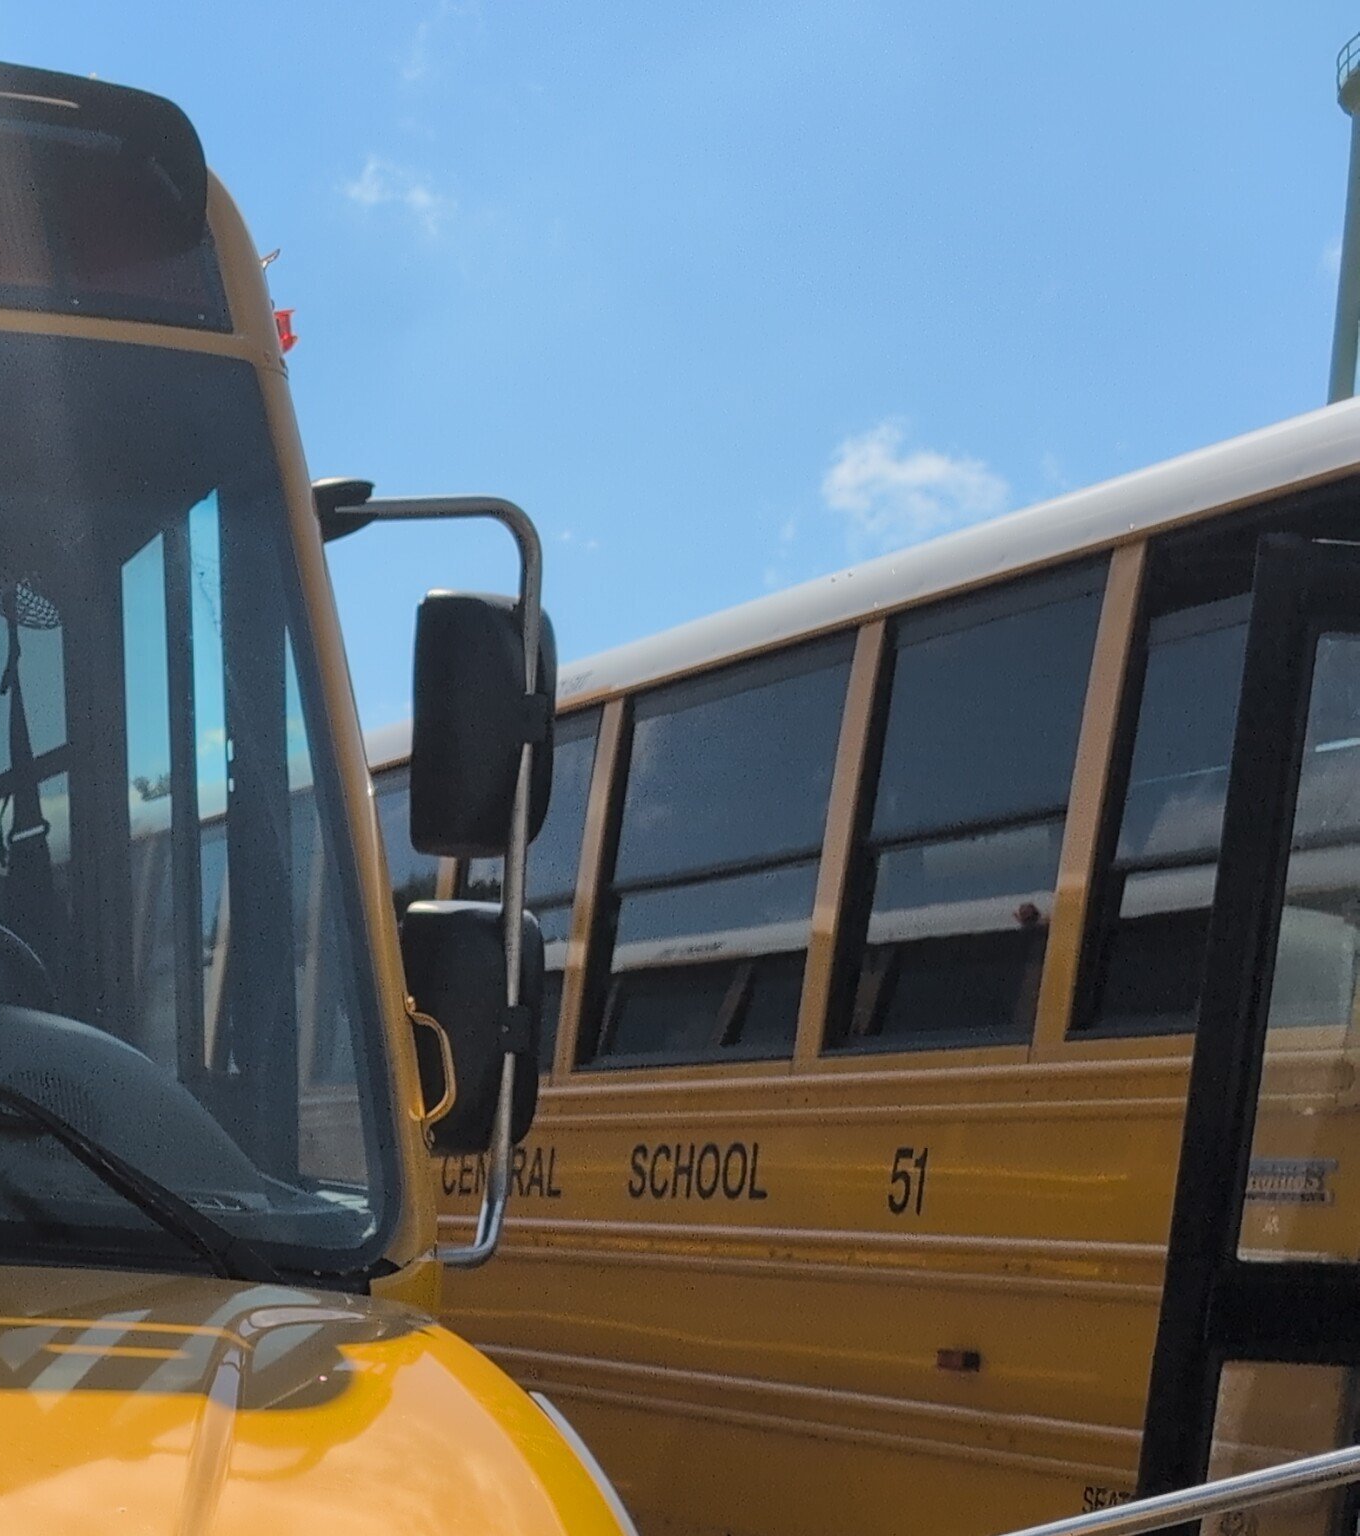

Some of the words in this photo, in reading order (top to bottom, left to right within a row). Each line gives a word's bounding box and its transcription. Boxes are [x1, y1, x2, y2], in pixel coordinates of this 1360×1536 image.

[441, 1147, 562, 1197] CENRAL
[628, 1142, 768, 1200] SCHOOL
[887, 1146, 929, 1216] 51
